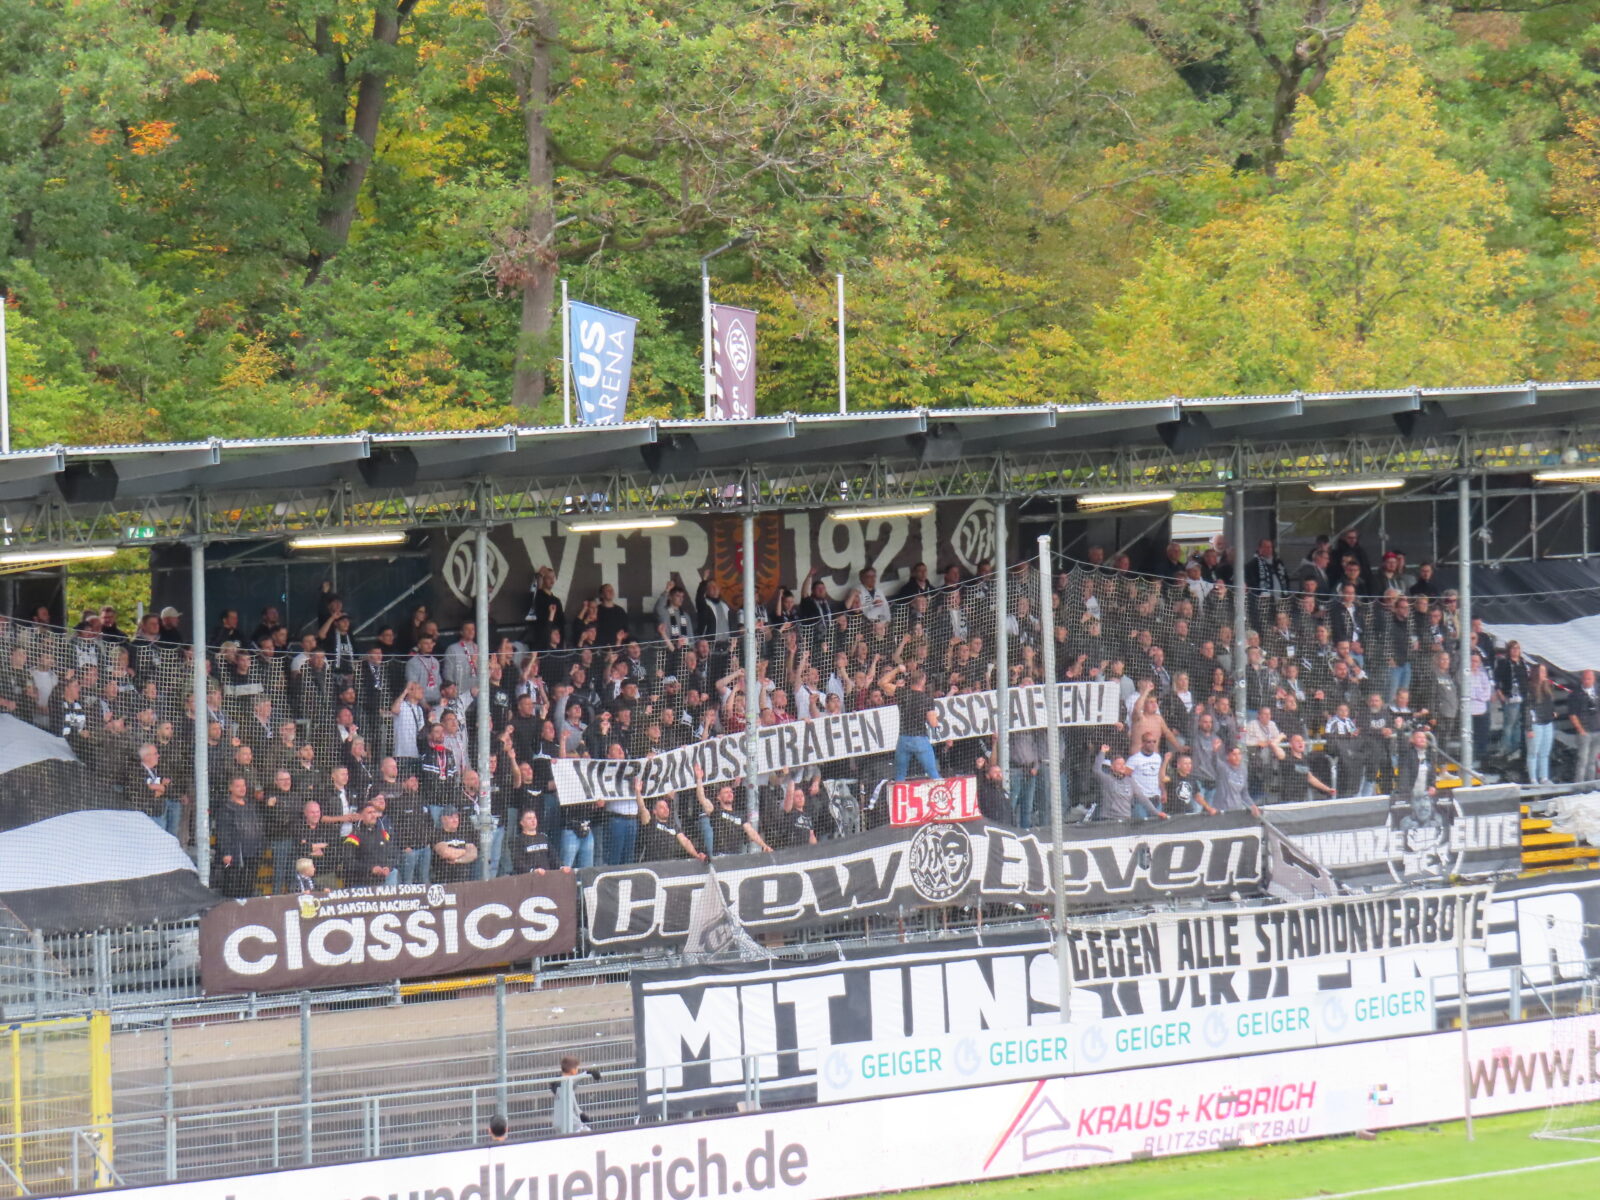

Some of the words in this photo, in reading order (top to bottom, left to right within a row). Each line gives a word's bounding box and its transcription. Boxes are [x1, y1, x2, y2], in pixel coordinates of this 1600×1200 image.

[595, 330, 626, 422] ARENA
[512, 519, 709, 613] VfR
[784, 506, 944, 603] 1921
[930, 684, 1105, 739] BSCHAFEN!
[1296, 828, 1406, 865] HWARZE
[1451, 813, 1518, 849] ELITE
[352, 887, 374, 897] SOLL
[376, 885, 397, 896] MAN
[399, 883, 427, 894] SONST
[588, 848, 903, 945] Crew
[980, 826, 1262, 896] Eleven
[319, 904, 336, 917] AM
[337, 901, 378, 914] SAMSTAG
[223, 896, 559, 975] classics
[1067, 922, 1161, 981] GEGEN
[1177, 914, 1240, 970] ALLE
[1256, 890, 1487, 962] STADIONVERBOTE
[1237, 1007, 1310, 1037] GEIGER
[1354, 989, 1426, 1022] GEIGER
[644, 973, 846, 1090] MIT
[989, 1036, 1068, 1066] GEIGER
[1116, 1021, 1191, 1053] GEIGER
[861, 1047, 942, 1079] GEIGER
[1076, 1099, 1172, 1138] KRAUS
[1177, 1105, 1190, 1122] +
